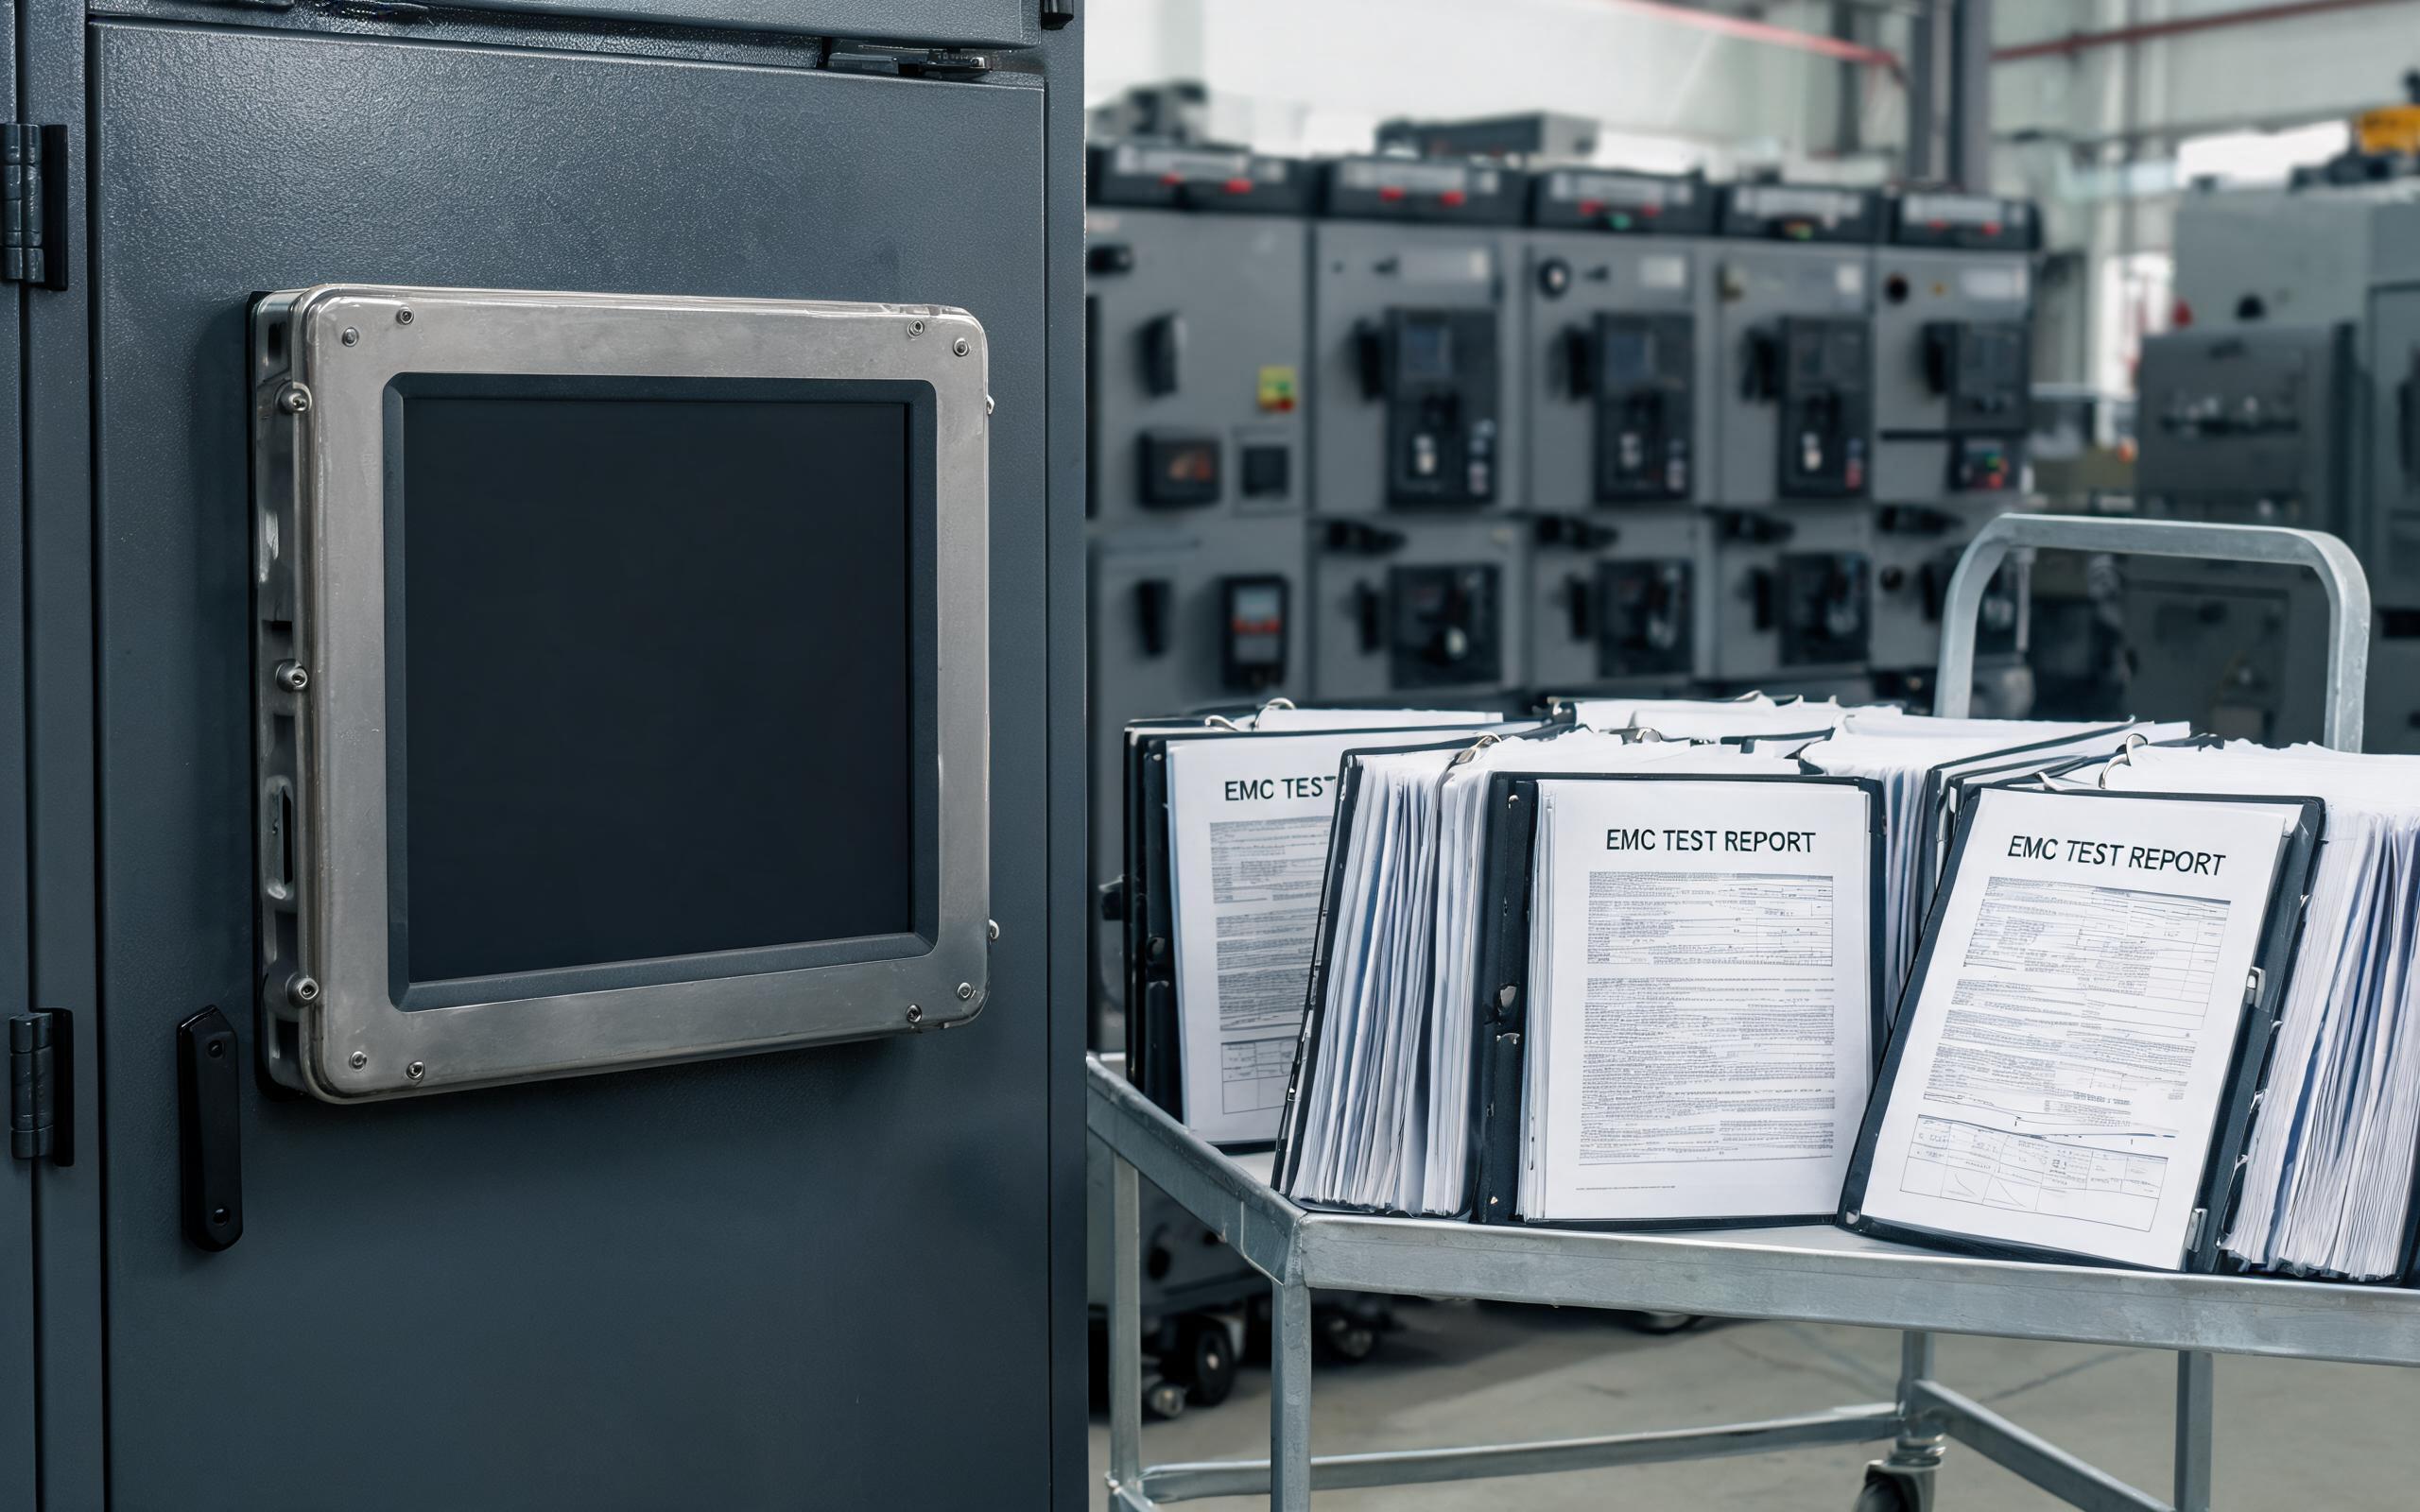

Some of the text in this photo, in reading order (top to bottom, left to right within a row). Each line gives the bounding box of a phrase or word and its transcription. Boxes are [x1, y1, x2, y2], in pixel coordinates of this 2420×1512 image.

[1224, 779, 1274, 801] EMC
[1606, 828, 1817, 853] EMC TEST REPORT
[2007, 834, 2226, 876] EMC TEST REPORT
